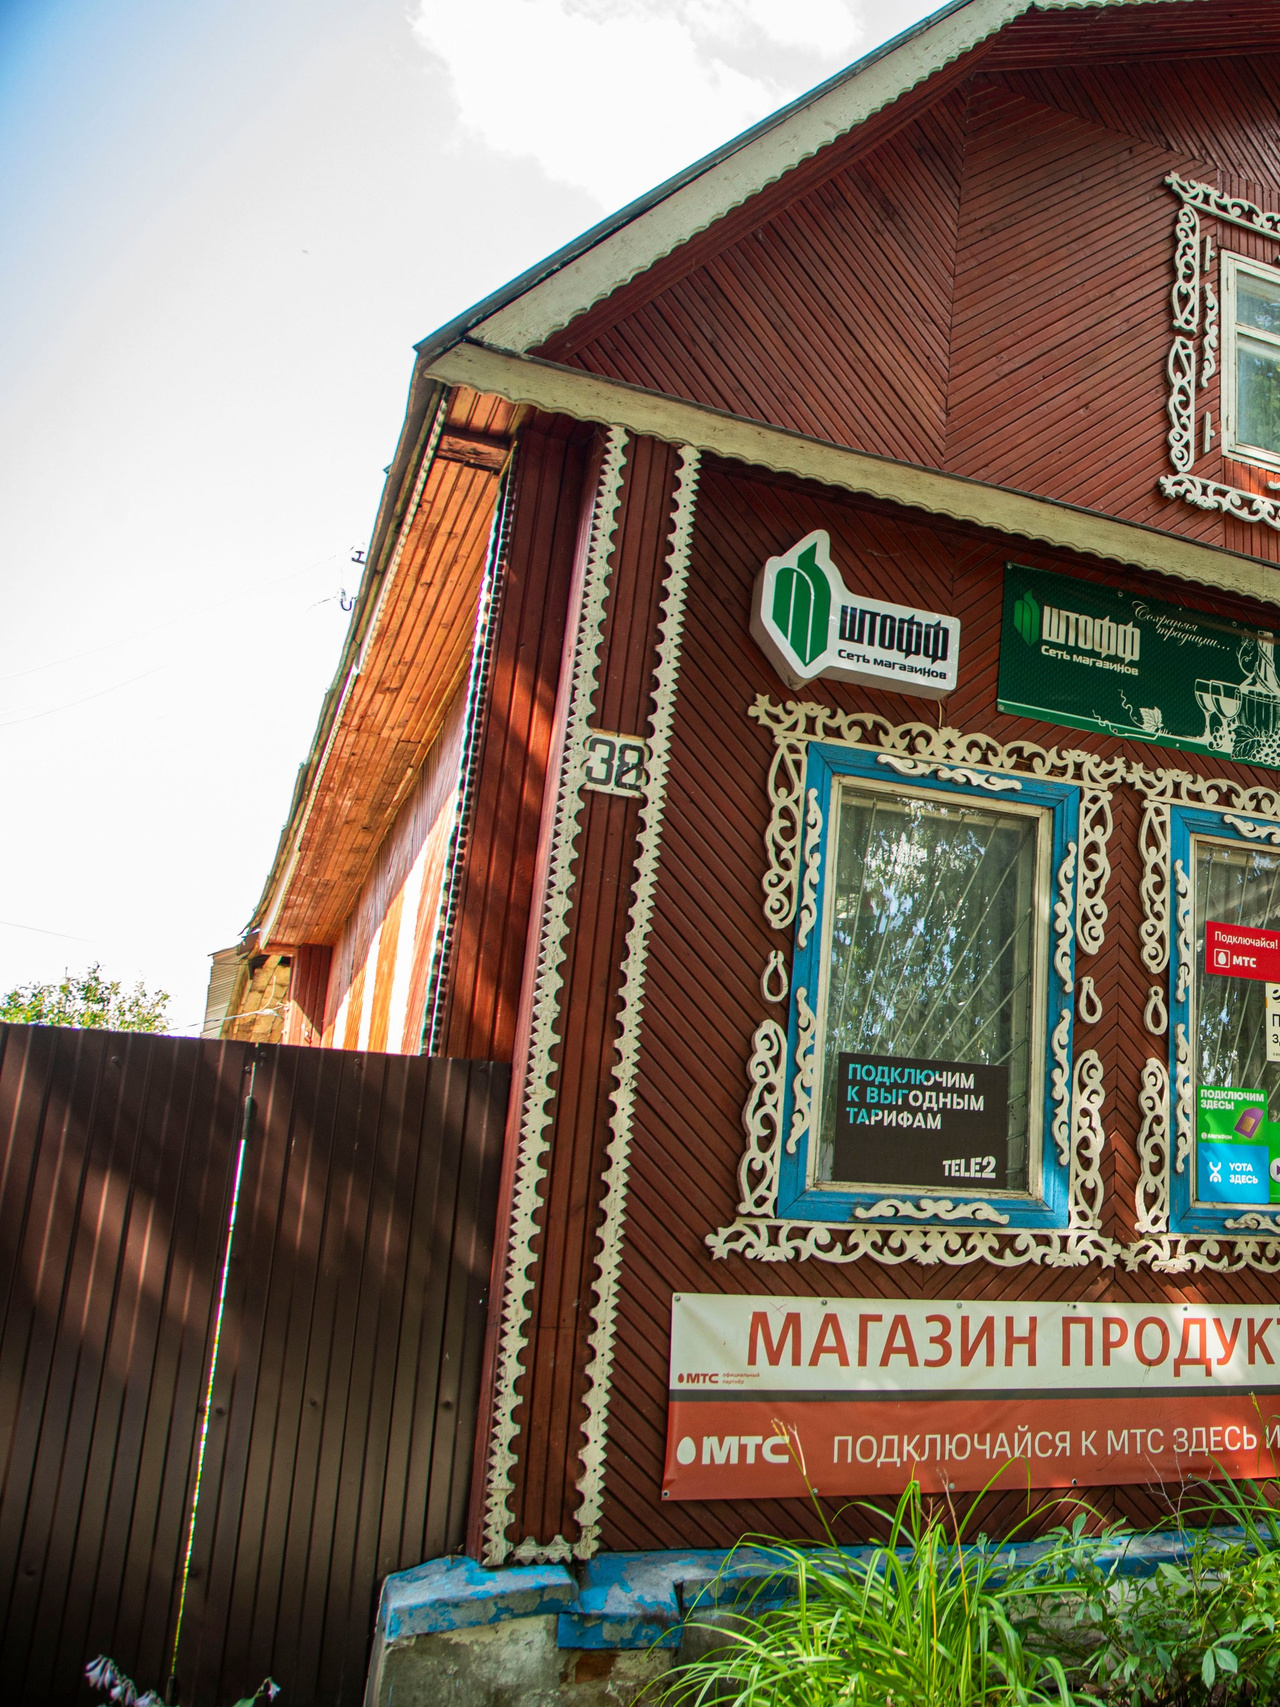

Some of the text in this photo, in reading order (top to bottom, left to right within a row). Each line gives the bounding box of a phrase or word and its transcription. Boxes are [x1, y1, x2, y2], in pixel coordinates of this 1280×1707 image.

[837, 648, 948, 680] Сеть магазинов
[1041, 645, 1139, 676] Сеть магазинов
[1214, 931, 1279, 950] Подключайся!
[1232, 955, 1257, 968] МТС
[848, 1063, 975, 1089] ПОДКЛЮЧИМ
[847, 1085, 985, 1112] К ВЫГОДНЫМ
[1200, 1089, 1265, 1102] ПОДКЛЮЧИМ
[846, 1107, 942, 1130] ТАРИФАМ
[942, 1155, 997, 1179] TELE2
[1228, 1162, 1254, 1172] YOTA
[1228, 1174, 1259, 1184] ЗДЕСЬ
[747, 1311, 1038, 1367] МАГАЗИН
[686, 1373, 719, 1384] МТС
[701, 1435, 790, 1465] МТС
[832, 1425, 1071, 1468] ПОДКЛЮЧАЙСЯ
[1081, 1430, 1098, 1456] К
[1107, 1428, 1165, 1454] МТС
[1173, 1426, 1257, 1457] ЗДЕСЬ
[1266, 1424, 1280, 1449] И
